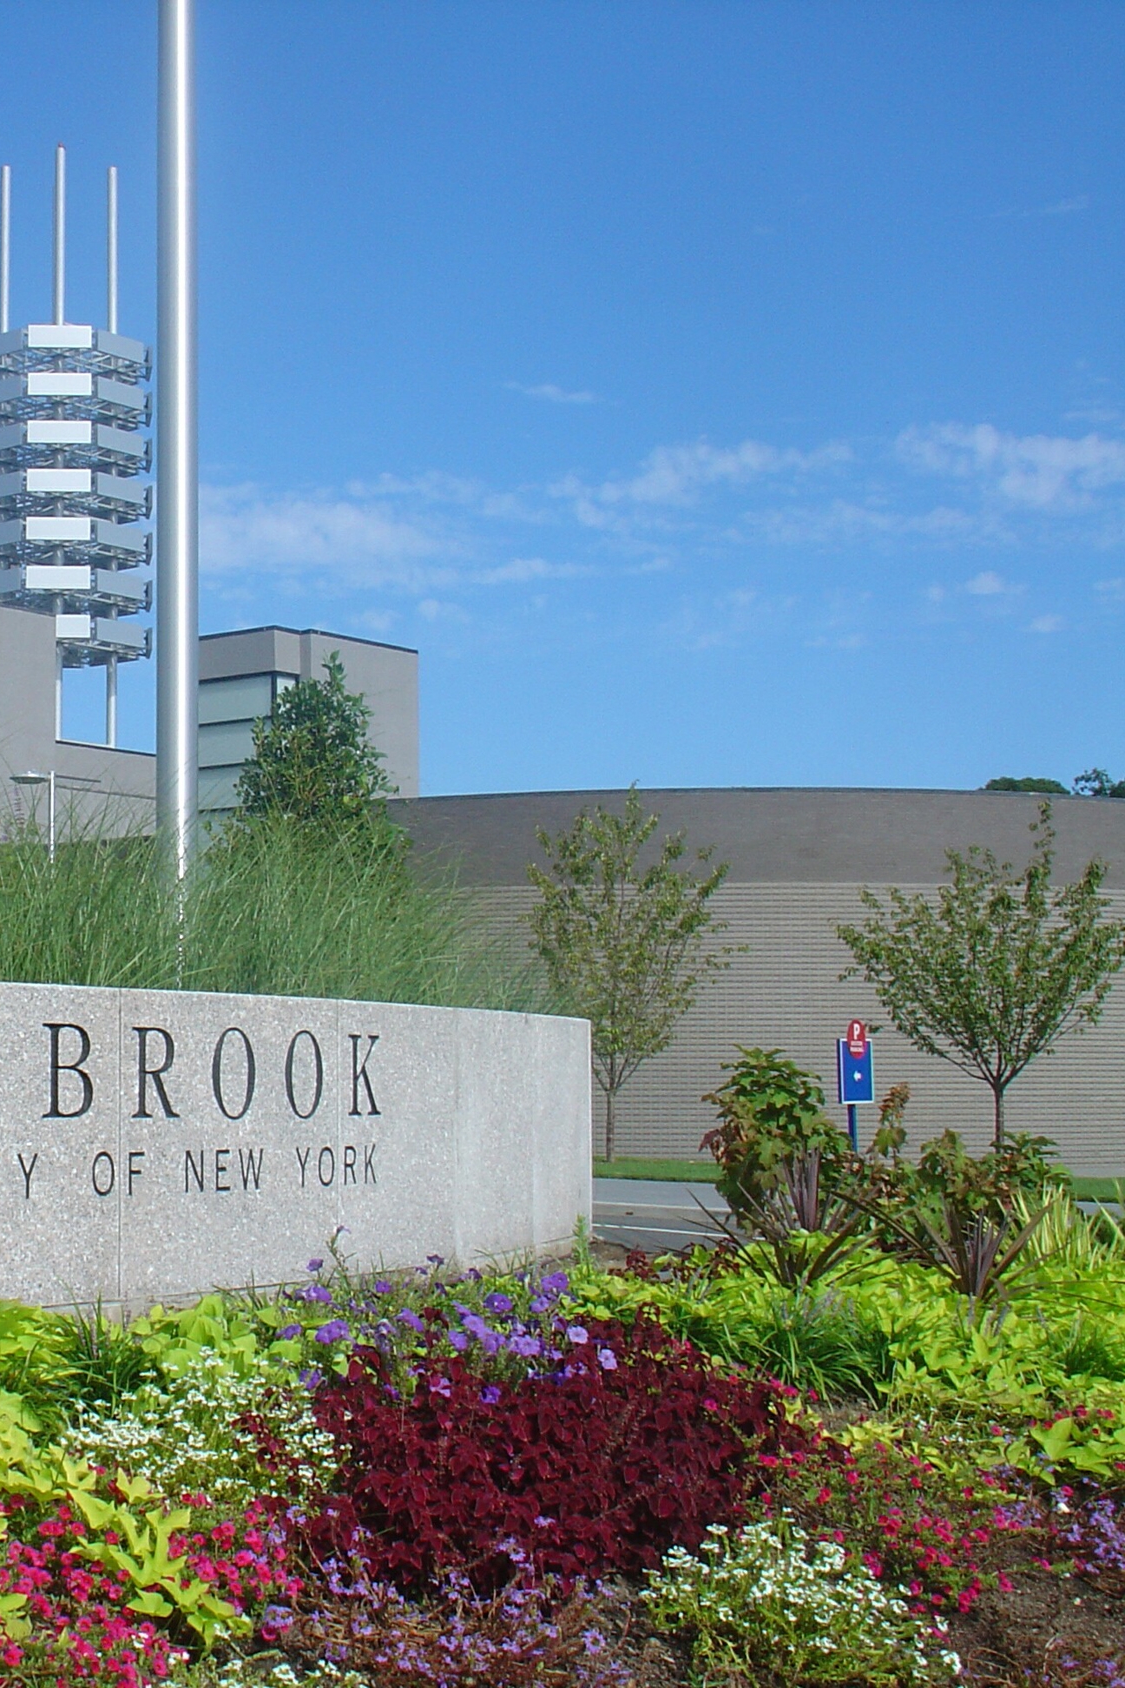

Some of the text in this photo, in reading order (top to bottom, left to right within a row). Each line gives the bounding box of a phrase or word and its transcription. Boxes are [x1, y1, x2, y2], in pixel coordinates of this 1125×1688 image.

[853, 1023, 861, 1040] P
[41, 1022, 382, 1120] BROOK
[91, 1151, 147, 1197] OF
[184, 1148, 265, 1194] NEW
[295, 1142, 378, 1188] YORK
